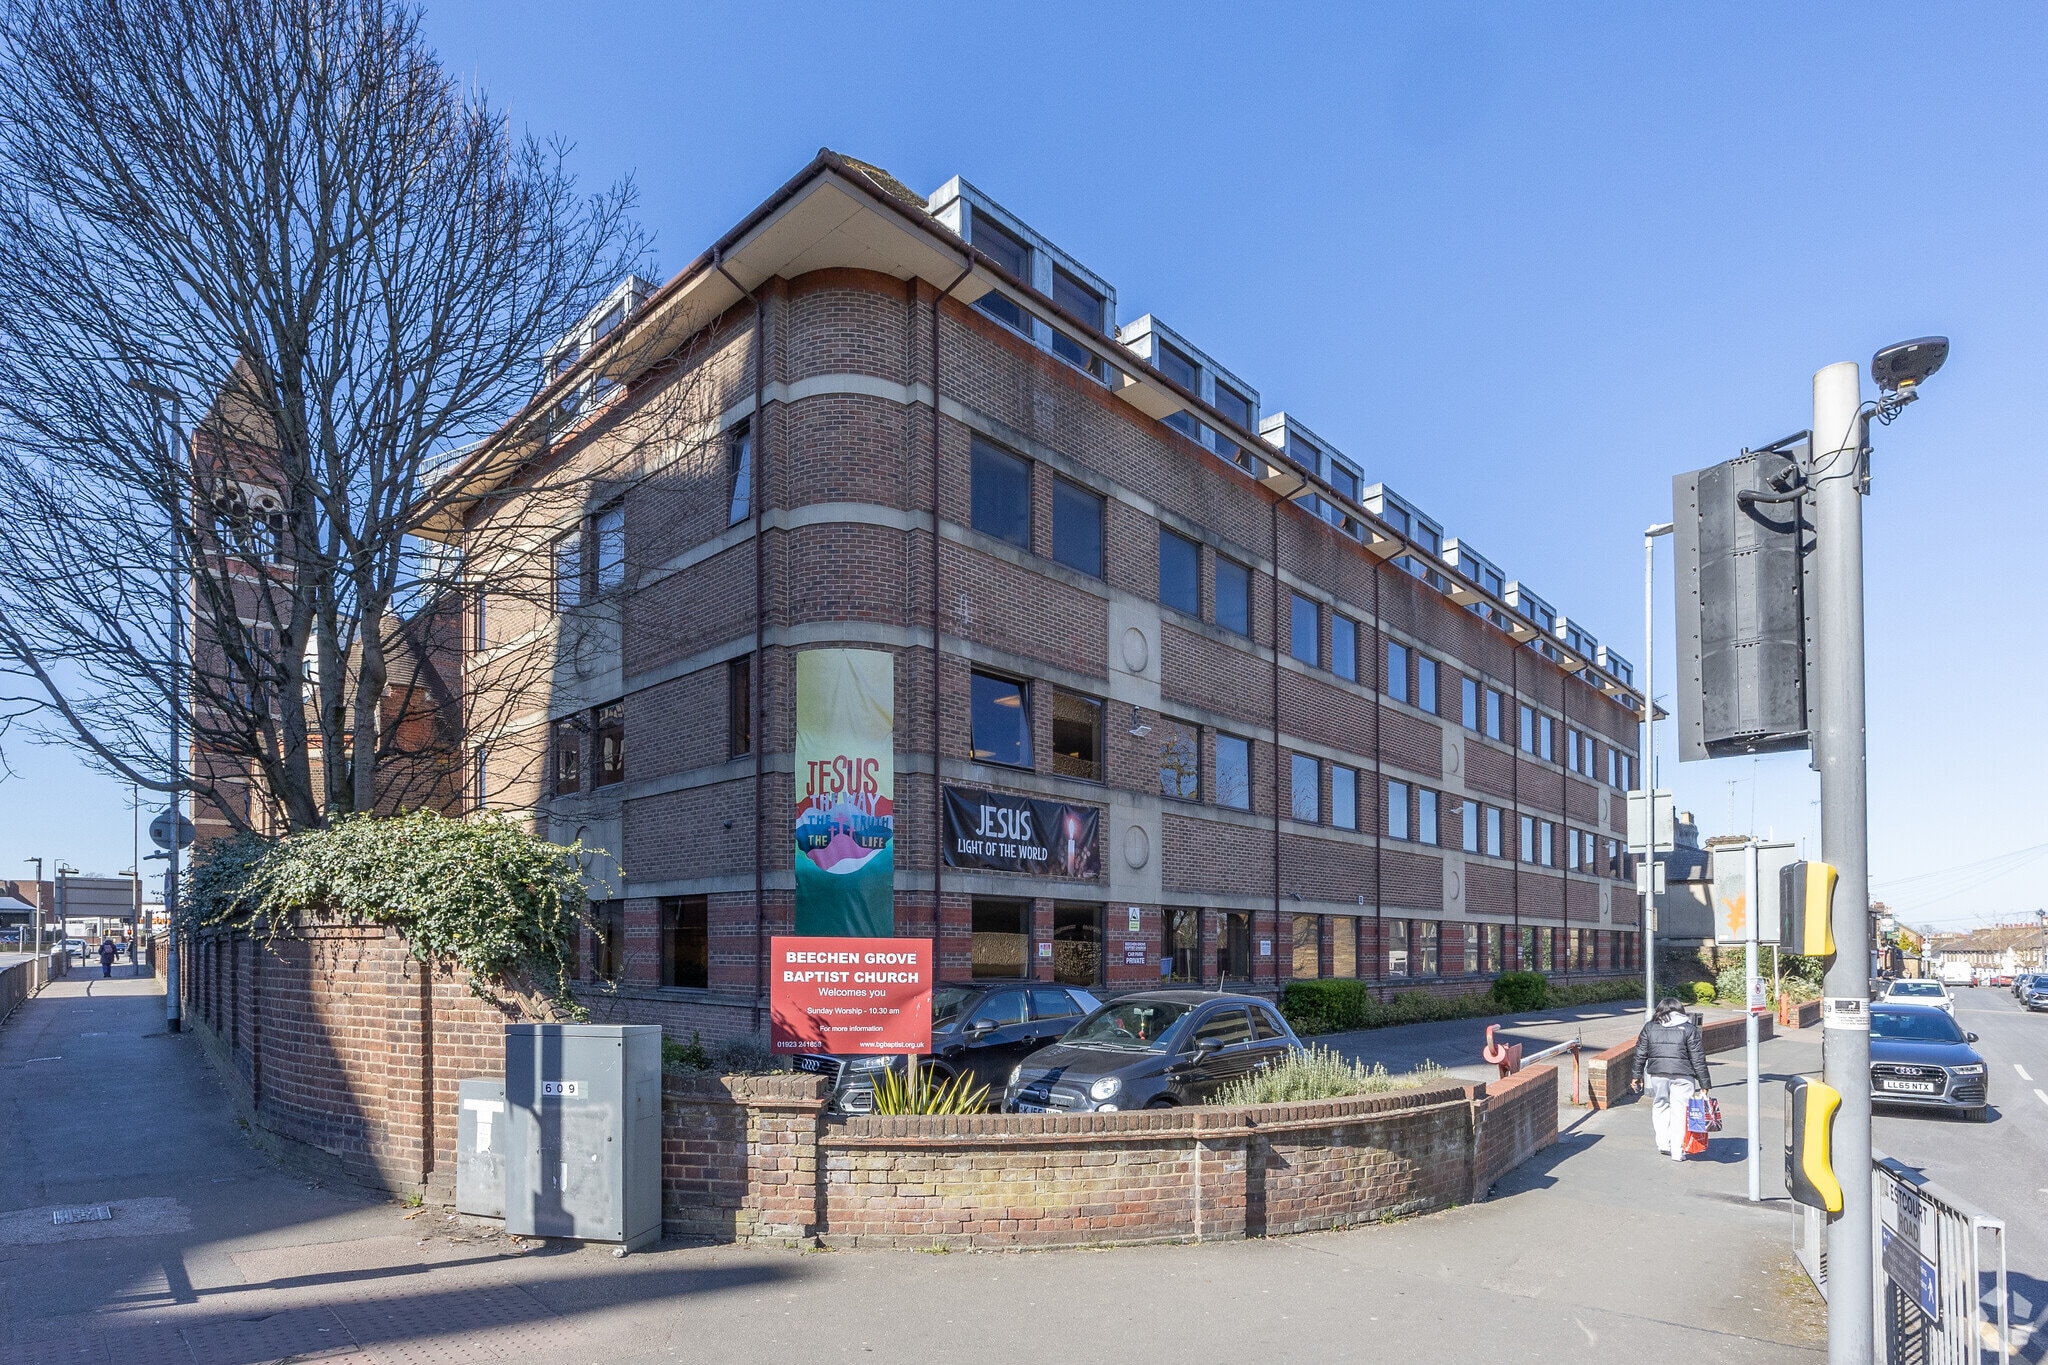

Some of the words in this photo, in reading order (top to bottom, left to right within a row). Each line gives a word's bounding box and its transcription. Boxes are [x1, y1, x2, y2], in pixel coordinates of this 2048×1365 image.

[806, 755, 879, 796] JESUS
[810, 792, 838, 811] THE
[843, 792, 881, 817] WAY
[808, 815, 831, 825] THE
[851, 815, 889, 831] TRUTH
[976, 805, 1032, 841] JESUS
[808, 835, 828, 847] THE
[861, 836, 884, 848] LIFE
[957, 838, 983, 855] LIGHT
[985, 842, 998, 857] OF
[998, 843, 1017, 858] THE
[1018, 845, 1048, 861] WORLD
[786, 952, 860, 964] BEECHEN
[864, 952, 917, 964] GROVE
[783, 971, 850, 983] BAPTIST
[854, 972, 919, 983] CHURCH
[818, 987, 867, 997] Welcomes
[869, 989, 886, 998] you
[807, 1007, 834, 1015] Sunday
[835, 1007, 862, 1015] Worship
[860, 1041, 925, 1049] www.bgbaptist.org.uk
[1887, 1081, 1910, 1089] LL65
[1912, 1082, 1929, 1090] NTX
[1890, 1183, 1928, 1226] ESTCOURT
[1899, 1212, 1919, 1243] ROAD
